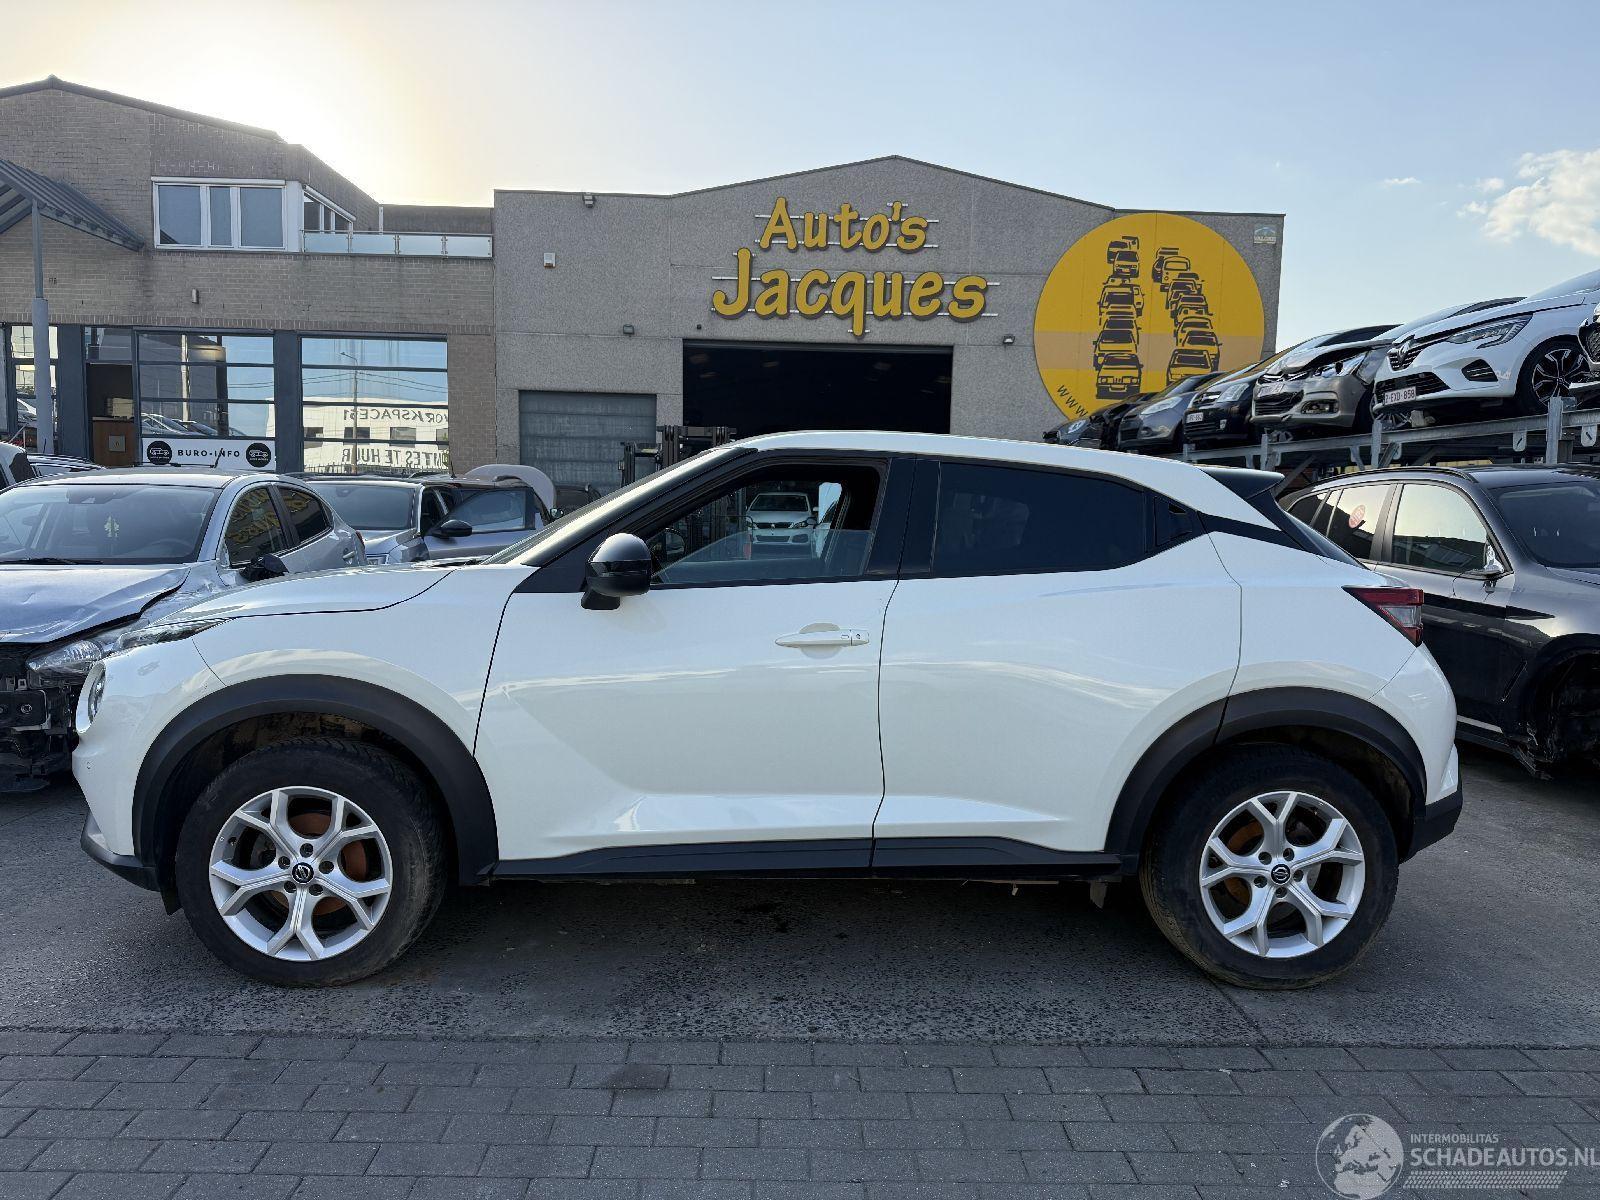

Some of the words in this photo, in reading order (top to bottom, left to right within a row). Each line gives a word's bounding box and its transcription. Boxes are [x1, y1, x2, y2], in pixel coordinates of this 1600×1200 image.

[759, 197, 928, 252] Auto's
[712, 247, 988, 338] Jacques
[1057, 385, 1088, 417] www
